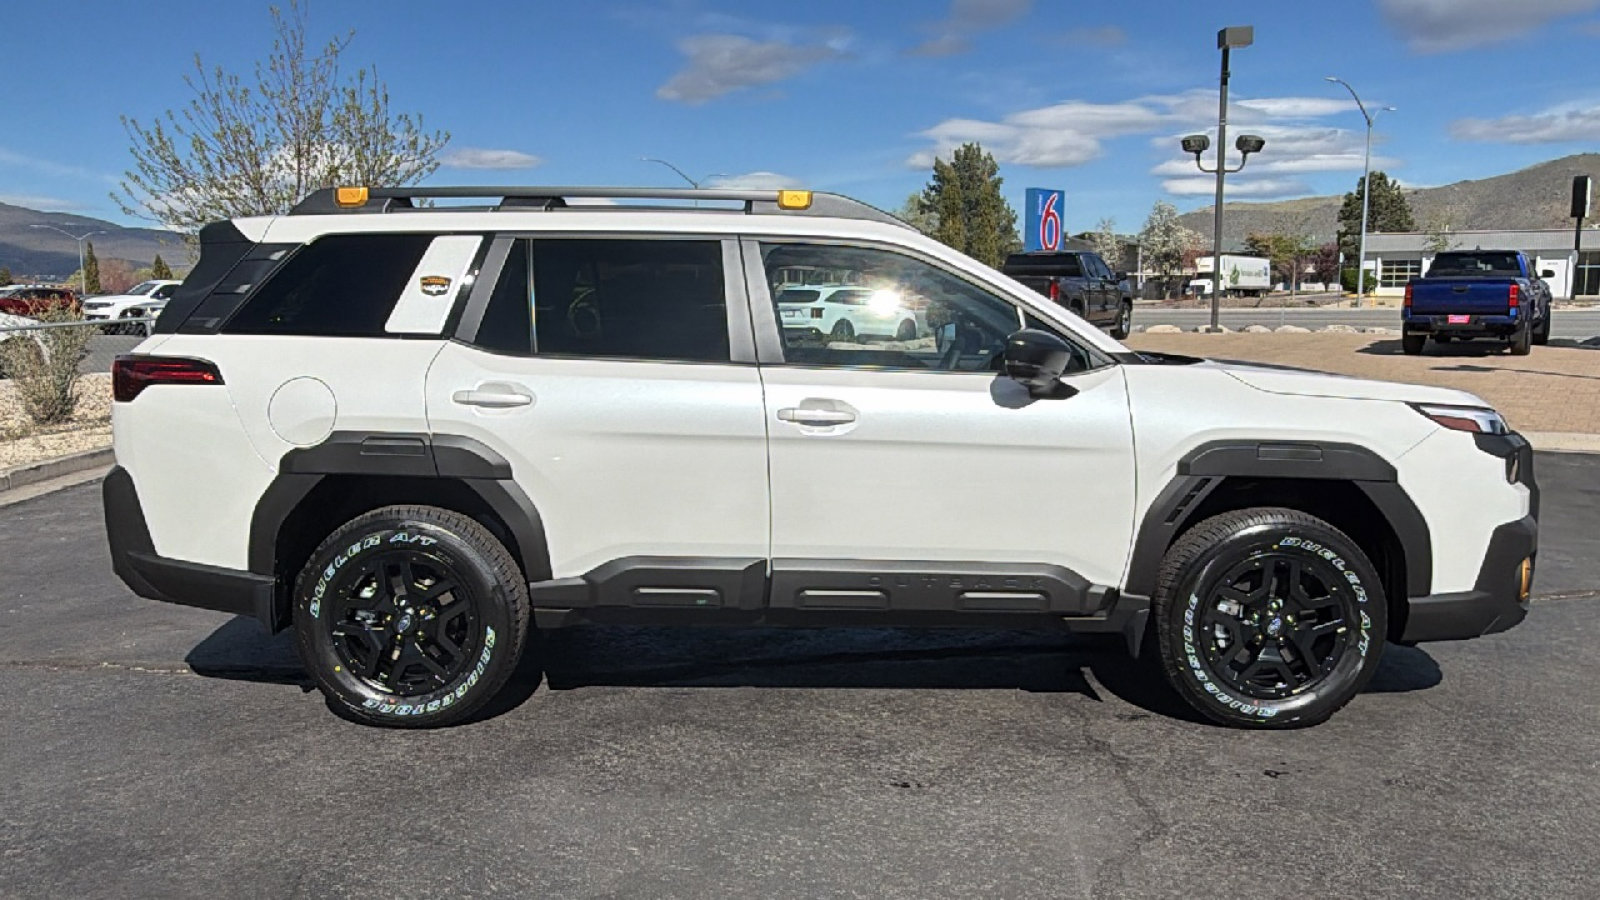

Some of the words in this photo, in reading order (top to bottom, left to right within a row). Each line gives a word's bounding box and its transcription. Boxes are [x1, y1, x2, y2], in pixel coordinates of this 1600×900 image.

[1040, 192, 1060, 250] 6
[310, 535, 381, 618] DUELER
[390, 532, 438, 546] A/T
[1358, 609, 1372, 657] A/T
